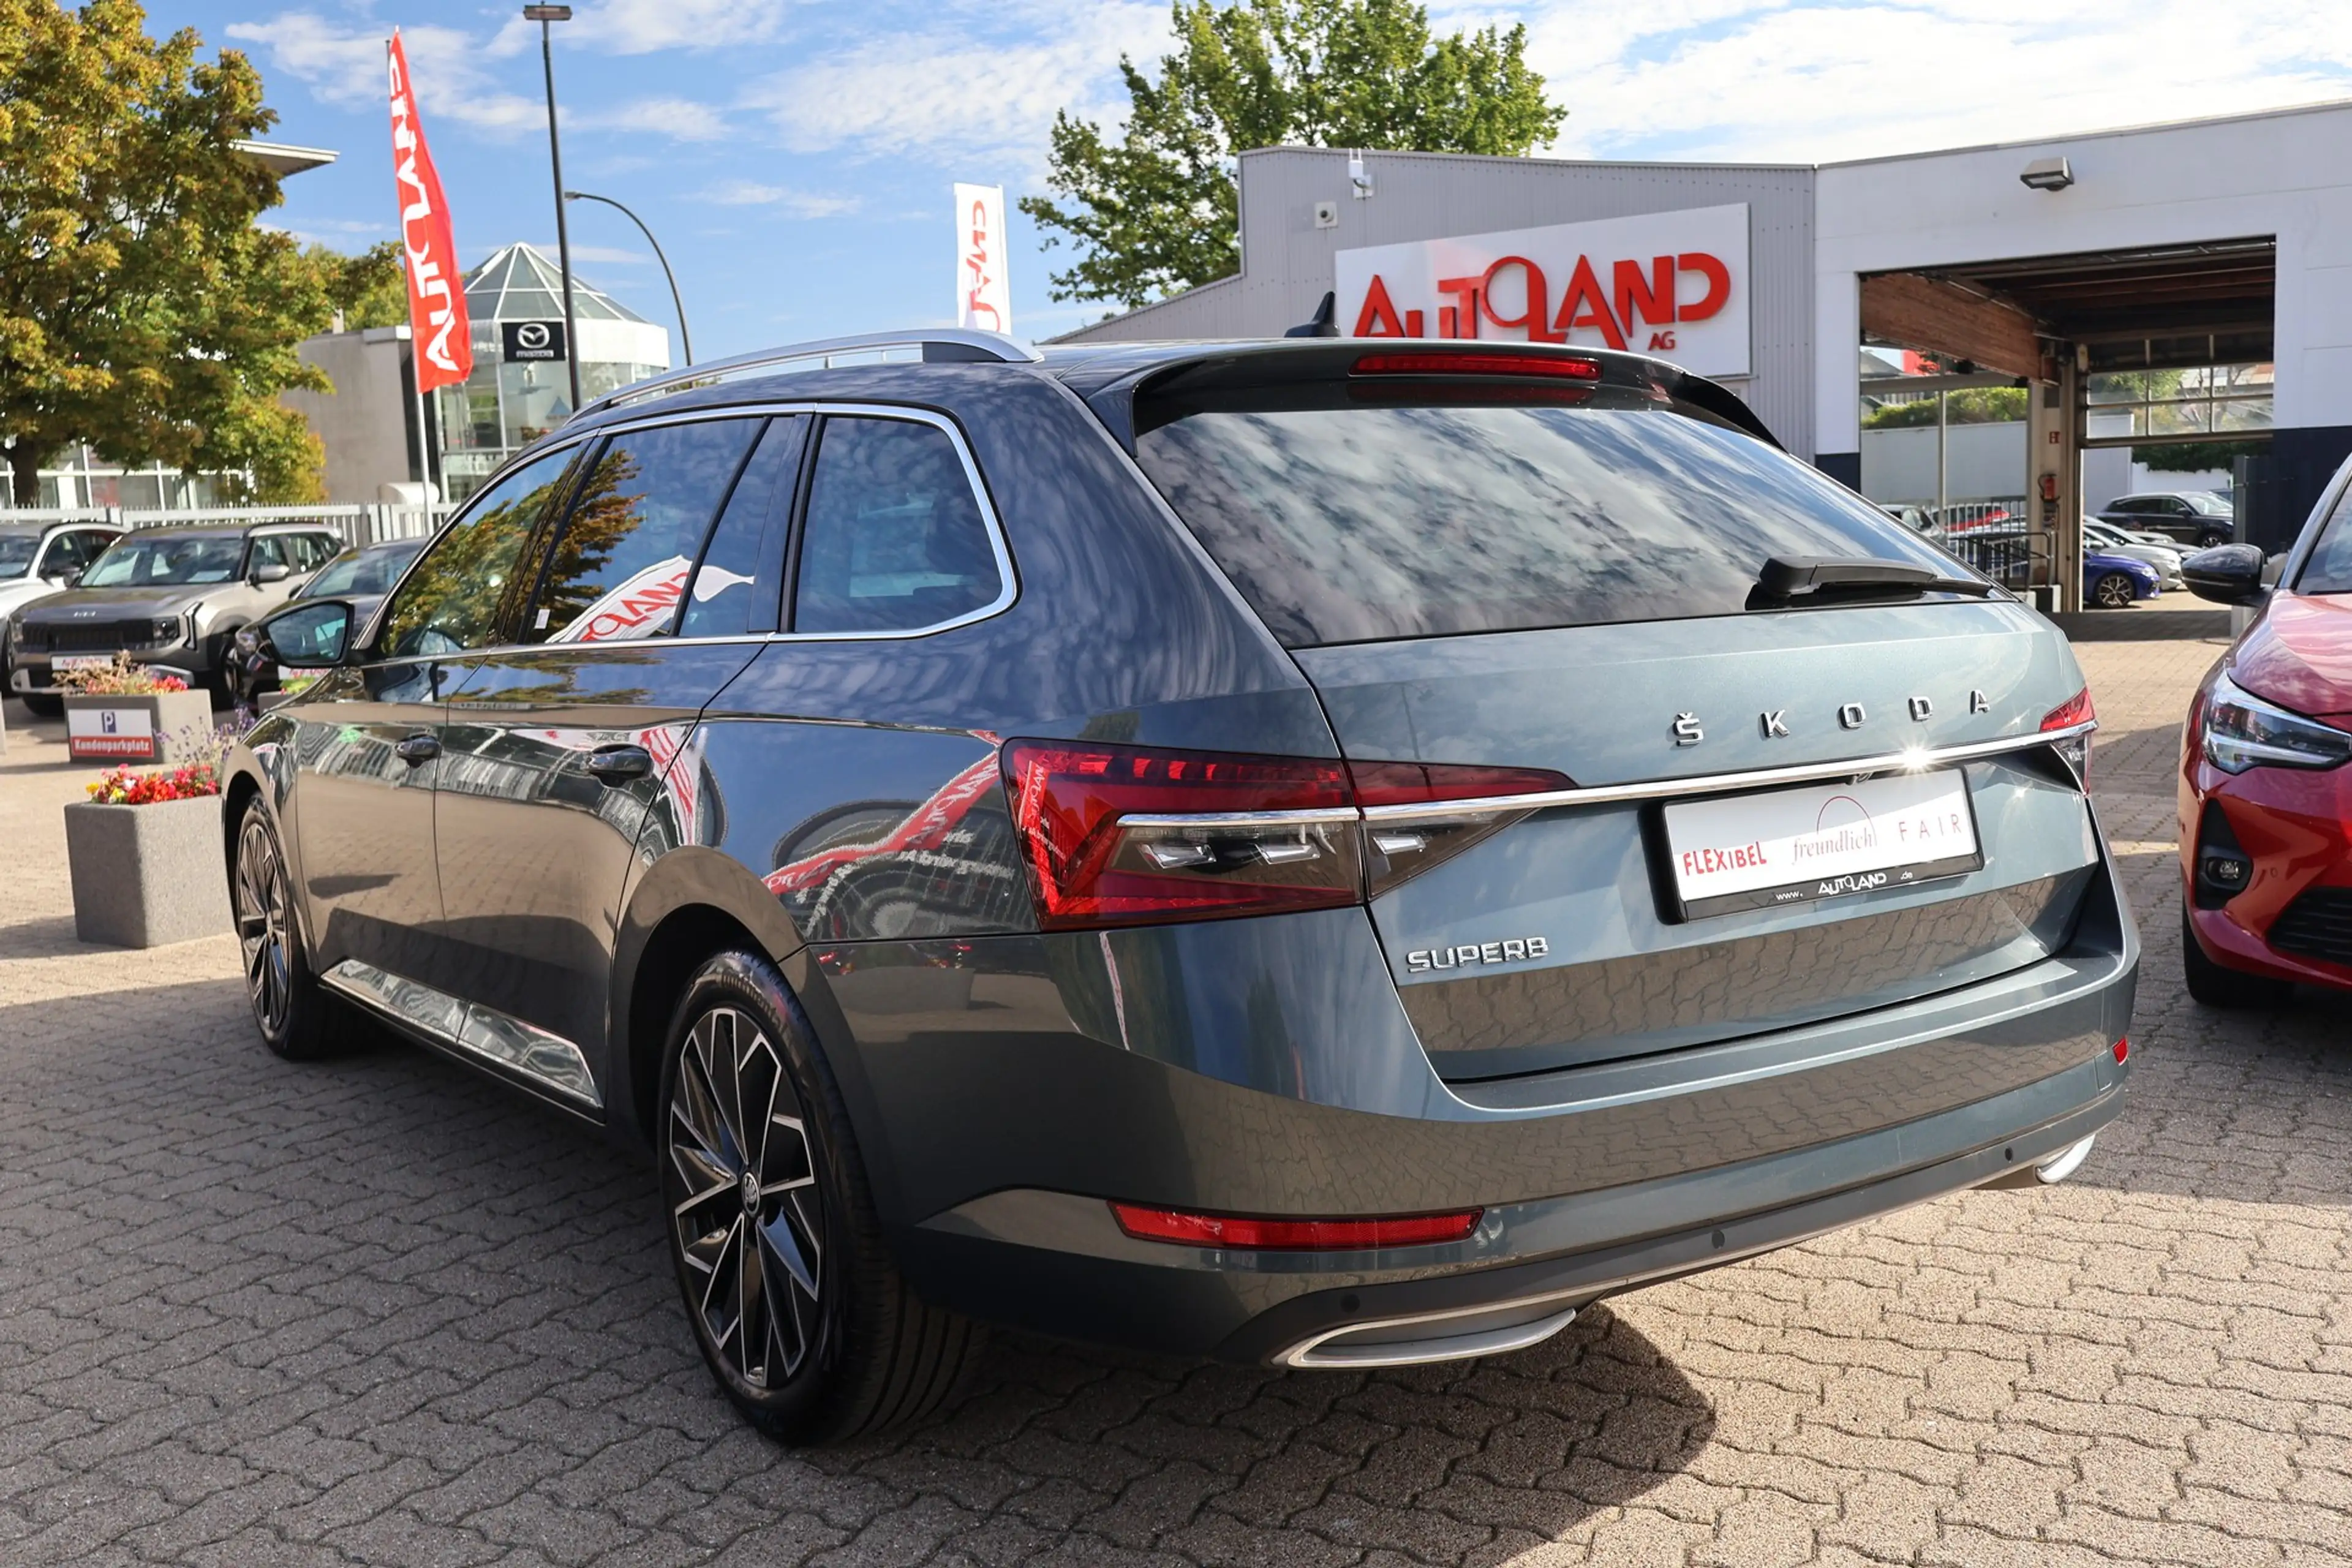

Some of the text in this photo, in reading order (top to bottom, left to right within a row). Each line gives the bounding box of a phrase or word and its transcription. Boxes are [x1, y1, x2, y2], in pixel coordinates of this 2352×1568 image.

[1352, 252, 1731, 351] AUTOLAND
[516, 350, 554, 358] mazda
[1648, 331, 1676, 351] AG
[1675, 689, 1990, 746] ŠKODA
[75, 739, 149, 753] Kundenparkplatz
[1683, 813, 1962, 876] FLEXIBEL freundlich FAIR
[1818, 872, 1887, 895] AUTOLAND
[1407, 937, 1549, 973] SUPERB
